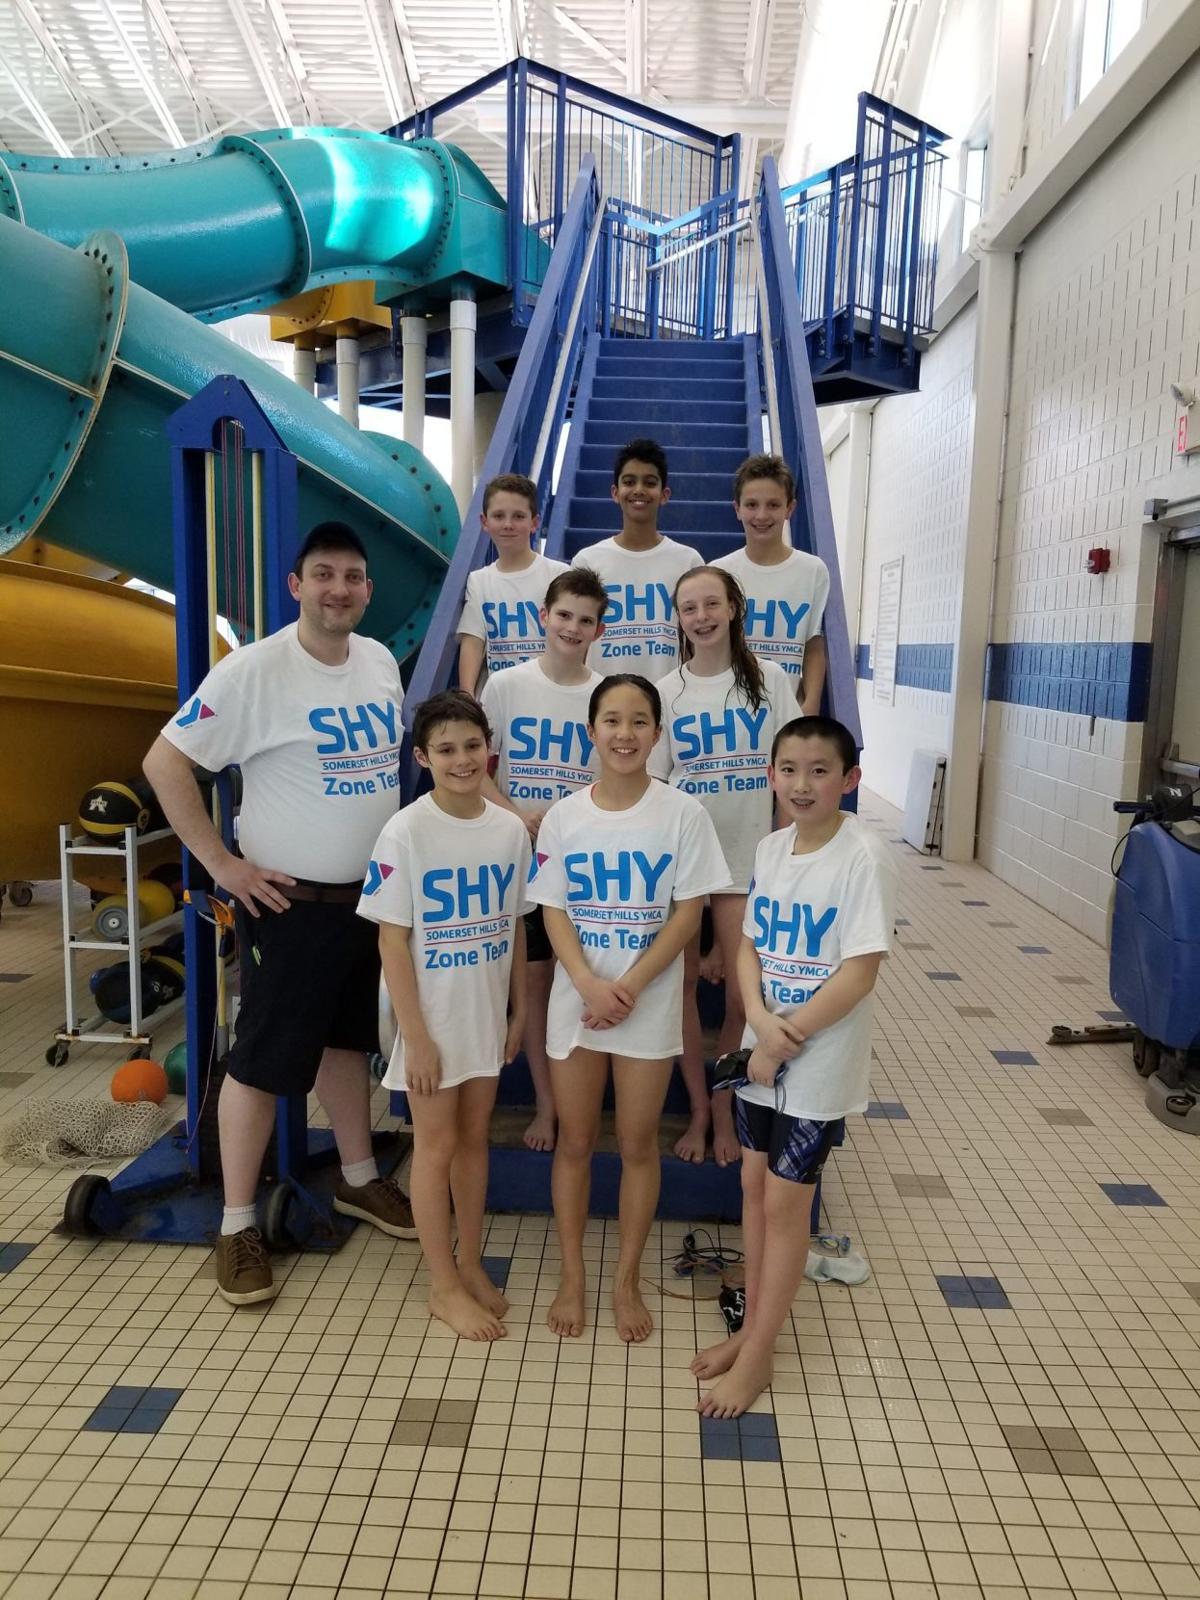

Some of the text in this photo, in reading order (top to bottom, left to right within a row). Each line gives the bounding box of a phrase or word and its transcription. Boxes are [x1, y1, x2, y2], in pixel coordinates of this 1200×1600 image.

[602, 583, 676, 624] SHY
[745, 599, 811, 639] HY
[603, 628, 642, 637] SOMERSET
[643, 626, 661, 635] HILLS
[489, 643, 514, 652] OMERSET
[601, 641, 676, 658] Zone Team
[760, 644, 780, 652] HILLS
[781, 645, 803, 654] YMCA
[308, 701, 397, 755] SHY
[672, 707, 768, 760] SHY
[508, 716, 595, 767] SHY
[322, 758, 369, 771] SOMERSET
[370, 754, 389, 766] HILLS
[683, 757, 767, 773] ERSET HILLS YMCA
[510, 766, 554, 777] SOMERSET
[556, 769, 576, 780] HILLS
[724, 774, 768, 792] Team
[322, 771, 400, 796] Zone Tea
[509, 781, 574, 800] Zone Te
[564, 850, 673, 902] SHY
[422, 863, 515, 923] SHY
[572, 907, 662, 921] SOMERSET HILLS YMCA
[426, 919, 509, 941] SOMERSET HILLS CA
[753, 895, 838, 957] SHY
[424, 948, 479, 969] Zone
[773, 962, 797, 975] HILLS
[798, 965, 829, 977] YMCA
